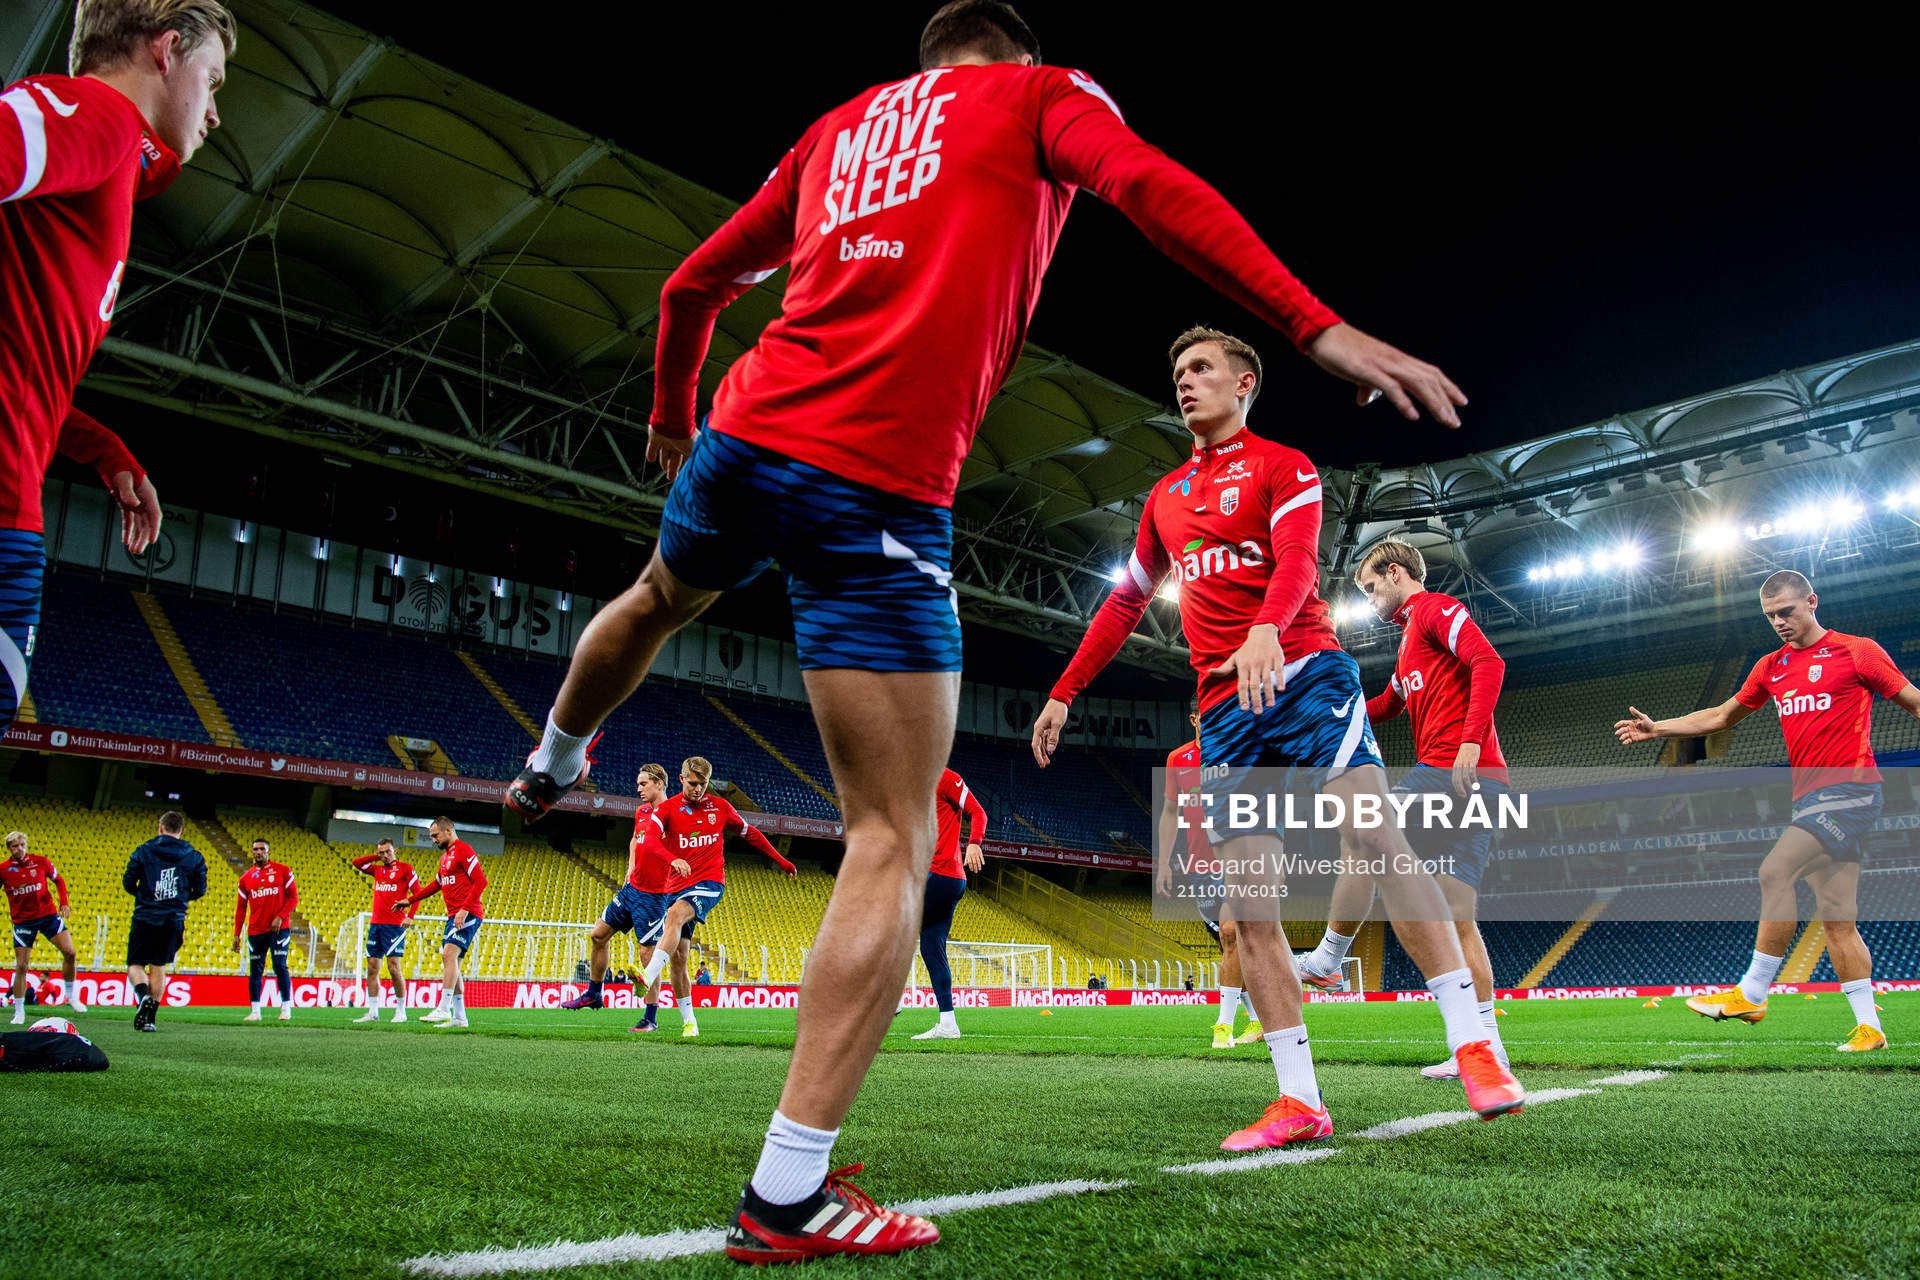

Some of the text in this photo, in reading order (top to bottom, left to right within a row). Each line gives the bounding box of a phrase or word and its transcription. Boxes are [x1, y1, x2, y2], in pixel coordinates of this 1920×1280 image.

[864, 67, 954, 120] EAT
[829, 92, 957, 183] MOVE
[819, 148, 942, 235] SLEEP
[839, 235, 904, 262] bama
[1215, 441, 1244, 455] bama
[1169, 539, 1264, 588] bama
[1773, 691, 1832, 718] bama
[70, 734, 166, 757] MilliTakimlar1923
[180, 747, 265, 770] #BizimÇocuklar
[286, 760, 350, 780] millitakimlar
[369, 771, 428, 788] millitakimlar
[515, 790, 539, 811] COPA
[1816, 812, 1845, 842] bama
[1487, 848, 1528, 860] ADEM
[160, 867, 177, 881] EAT
[11, 882, 42, 896] bama
[154, 888, 178, 901] SLEEP
[155, 876, 179, 893] MOVE
[251, 886, 279, 899] bama
[717, 986, 799, 1008] McDon
[1015, 990, 1107, 1007] McDonald's
[1130, 991, 1207, 1006] McDonald's
